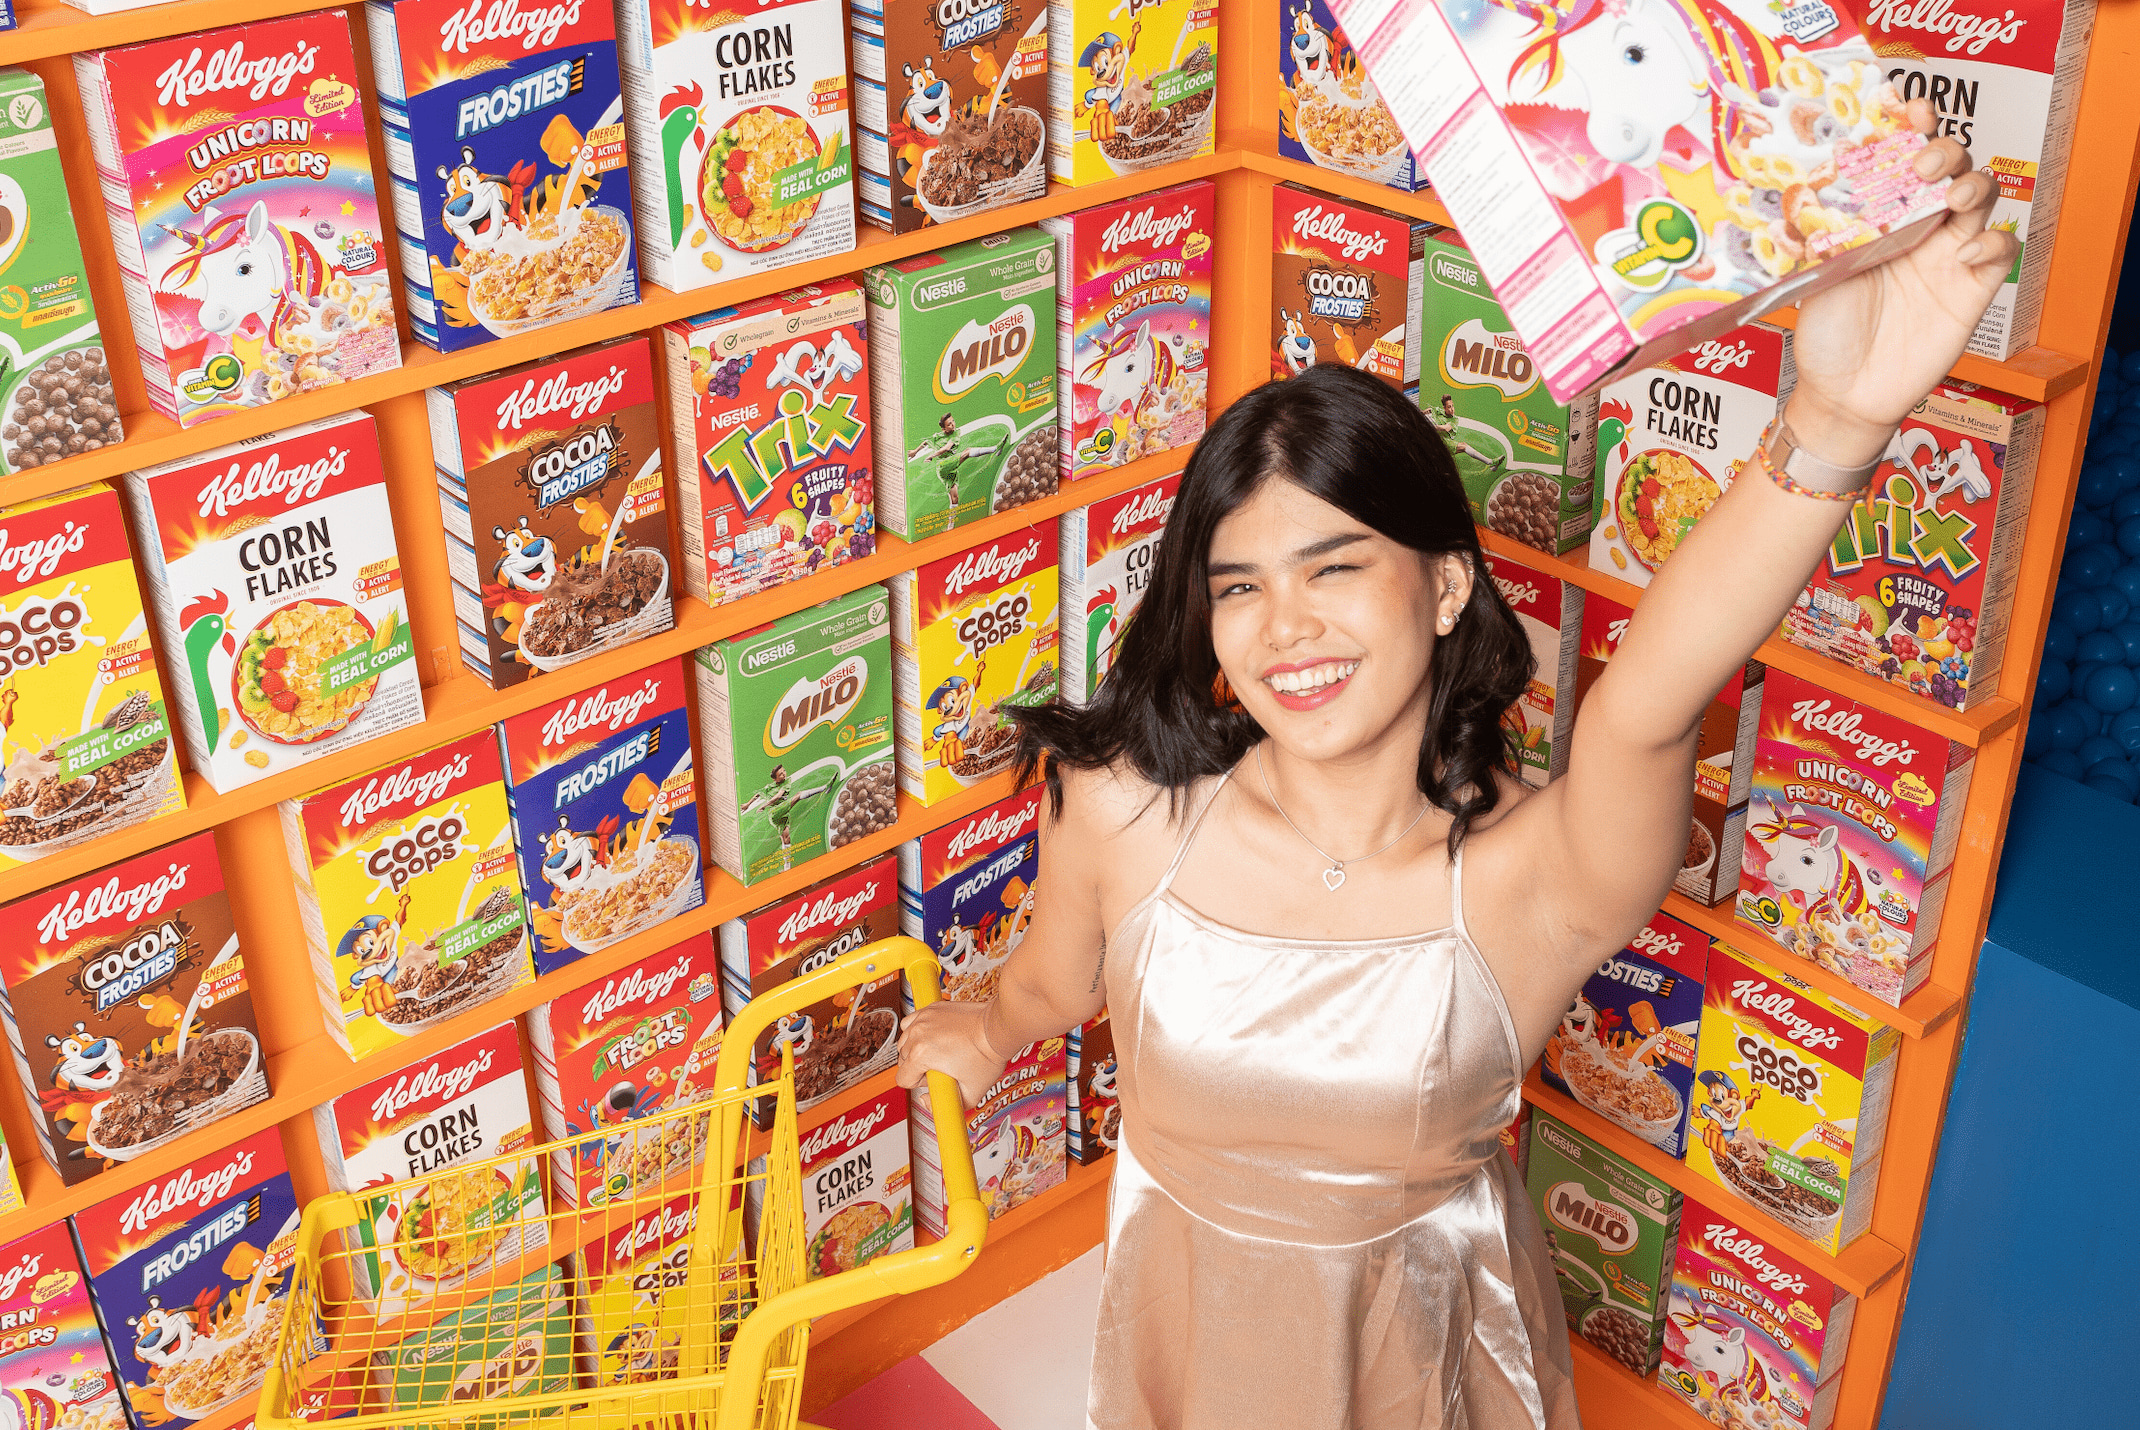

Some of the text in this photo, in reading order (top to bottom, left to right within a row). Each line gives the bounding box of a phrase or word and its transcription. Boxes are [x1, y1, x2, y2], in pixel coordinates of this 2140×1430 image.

[440, 0, 581, 53] Kellogg's
[716, 23, 793, 68] CORN
[942, 4, 1005, 50] FROSTIES
[157, 40, 319, 107] Kellogg's
[719, 60, 796, 99] FLAKES
[814, 77, 839, 91] ENERGY
[1156, 72, 1214, 103] REAL COCOA
[309, 87, 345, 107] Limited
[314, 98, 345, 112] Edition
[457, 63, 572, 137] FROSTIES
[820, 91, 840, 101] ACTIVE
[821, 103, 837, 112] ALERT
[189, 119, 308, 170] UNICORN
[589, 125, 622, 142] ENERGY
[597, 143, 622, 157] ACTIVE
[186, 153, 328, 208] FROOT LOOPS
[599, 157, 620, 170] ALERT
[781, 167, 814, 186] MADE WITH
[781, 163, 847, 200] REAL CORN
[1992, 156, 2027, 170] ENERGY
[1997, 175, 2023, 186] ACTIVE
[1101, 204, 1195, 253] Kellogg's
[1292, 205, 1388, 261] Kellogg's
[341, 252, 376, 267] COLOURS
[342, 246, 372, 259] NATURAL
[1437, 259, 1477, 286] Nestlé
[920, 258, 1035, 303] Nestlé Whole Grain
[1113, 261, 1183, 297] UNICORN
[1308, 273, 1370, 300] COCOA
[801, 314, 826, 327] Vitamins
[1105, 284, 1189, 326] FROOT LOOPS
[1312, 297, 1365, 318] FROSTIES
[740, 329, 774, 343] Wholegrain
[948, 325, 1027, 384] MILO
[1376, 339, 1401, 355] ENERGY
[1380, 355, 1399, 367] ACTIVE
[1380, 366, 1397, 377] ALERT
[1451, 338, 1533, 382] MILO
[496, 365, 627, 430] Kellogg's
[711, 404, 759, 431] Nestlé
[1649, 377, 1721, 426] CORN
[1928, 406, 1957, 421] Vitamins
[240, 432, 276, 447] FLAKES
[1647, 408, 1719, 450] FLAKES
[531, 424, 614, 481] COCOA
[703, 391, 866, 518] Trix
[197, 446, 350, 518] Kellogg's
[198, 446, 348, 518] Kellogg's
[540, 452, 609, 508] FROSTIES
[629, 474, 661, 493] ENERGY
[791, 479, 845, 509] 6 SHAPES
[804, 465, 846, 486] FRUITY
[637, 490, 661, 504] ACTIVE
[639, 503, 658, 517] ALERT
[239, 516, 332, 572] CORN
[245, 551, 337, 602] FLAKES
[360, 560, 389, 576] ENERGY
[369, 572, 391, 587] ACTIVE
[945, 538, 1042, 595] Kellogg's
[371, 585, 390, 597] ALERT
[1879, 577, 1941, 616] 6 SHAPES
[1897, 576, 1945, 602] FRUITY
[959, 596, 1028, 642] COCO
[973, 618, 1021, 658] pops
[106, 638, 139, 656] ENERGY
[116, 654, 141, 667] ACTIVE
[748, 614, 867, 669] Nestlé Whole Grain
[118, 666, 140, 678] ALERT
[330, 651, 367, 675] MADE WITH
[330, 642, 407, 689] REAL CORN
[541, 679, 661, 747] Kellogg's
[779, 675, 859, 739] MILO
[1029, 684, 1057, 706] COCOA
[67, 733, 109, 758] MADE WITH
[68, 719, 164, 772] REAL COCOA
[1790, 699, 1919, 766] Kellogg's
[340, 753, 472, 827] Kellogg's
[555, 733, 650, 809] FROSTIES
[663, 770, 692, 788] ENERGY
[1798, 761, 1892, 810] UNICORN
[670, 785, 692, 799] ACTIVE
[671, 796, 690, 808] ALERT
[1786, 785, 1896, 840] FROOT LOOPS
[368, 817, 463, 876] COCO
[947, 800, 1039, 859] Kellogg's
[390, 843, 456, 892] pops
[478, 844, 505, 860] ENERGY
[485, 857, 506, 869] ACTIVE
[487, 866, 505, 878] ALERT
[952, 843, 1025, 908] FROSTIES
[37, 863, 191, 944] Kellogg's
[778, 881, 880, 944] Kellogg's
[1879, 904, 1907, 919] COLOURS
[1880, 900, 1909, 913] NATURAL
[445, 910, 521, 958] REAL COCOA
[801, 926, 864, 976] COCOA
[85, 924, 182, 988] COCOA
[205, 957, 239, 979] ENERGY
[99, 950, 176, 1008] FROSTIES
[582, 956, 694, 1025] Kellogg's
[1784, 973, 1809, 990] pops
[1731, 980, 1844, 1050] Kellogg's
[605, 1011, 677, 1066] FROOT
[619, 1025, 686, 1070] LOOPS
[1737, 1036, 1818, 1091] COCO
[1751, 1061, 1807, 1102] pops
[371, 1049, 497, 1122] Kellogg's
[971, 1079, 1046, 1129] FROOT LOOPS
[976, 1064, 1040, 1109] UNICORN
[404, 1103, 478, 1156] CORN
[408, 1129, 483, 1178] FLAKES
[816, 1149, 872, 1194] CORN
[1774, 1154, 1790, 1166] MADE
[119, 1150, 256, 1236] Kellogg's
[818, 1171, 874, 1213] FLAKES
[1603, 1163, 1645, 1193] Whole Grain
[1772, 1160, 1841, 1199] REAL COCOA
[862, 1217, 910, 1258] REAL CORN
[1555, 1191, 1630, 1245] MILO
[142, 1203, 249, 1294] FROSTIES
[1704, 1224, 1810, 1295] Kellogg's
[35, 1275, 69, 1296] Limited
[41, 1283, 70, 1300] Edition
[1710, 1271, 1787, 1324] UNICORN
[1701, 1288, 1793, 1349] FROOT LOOPS
[73, 1378, 102, 1393] NATURAL
[73, 1382, 105, 1400] COLOURS
